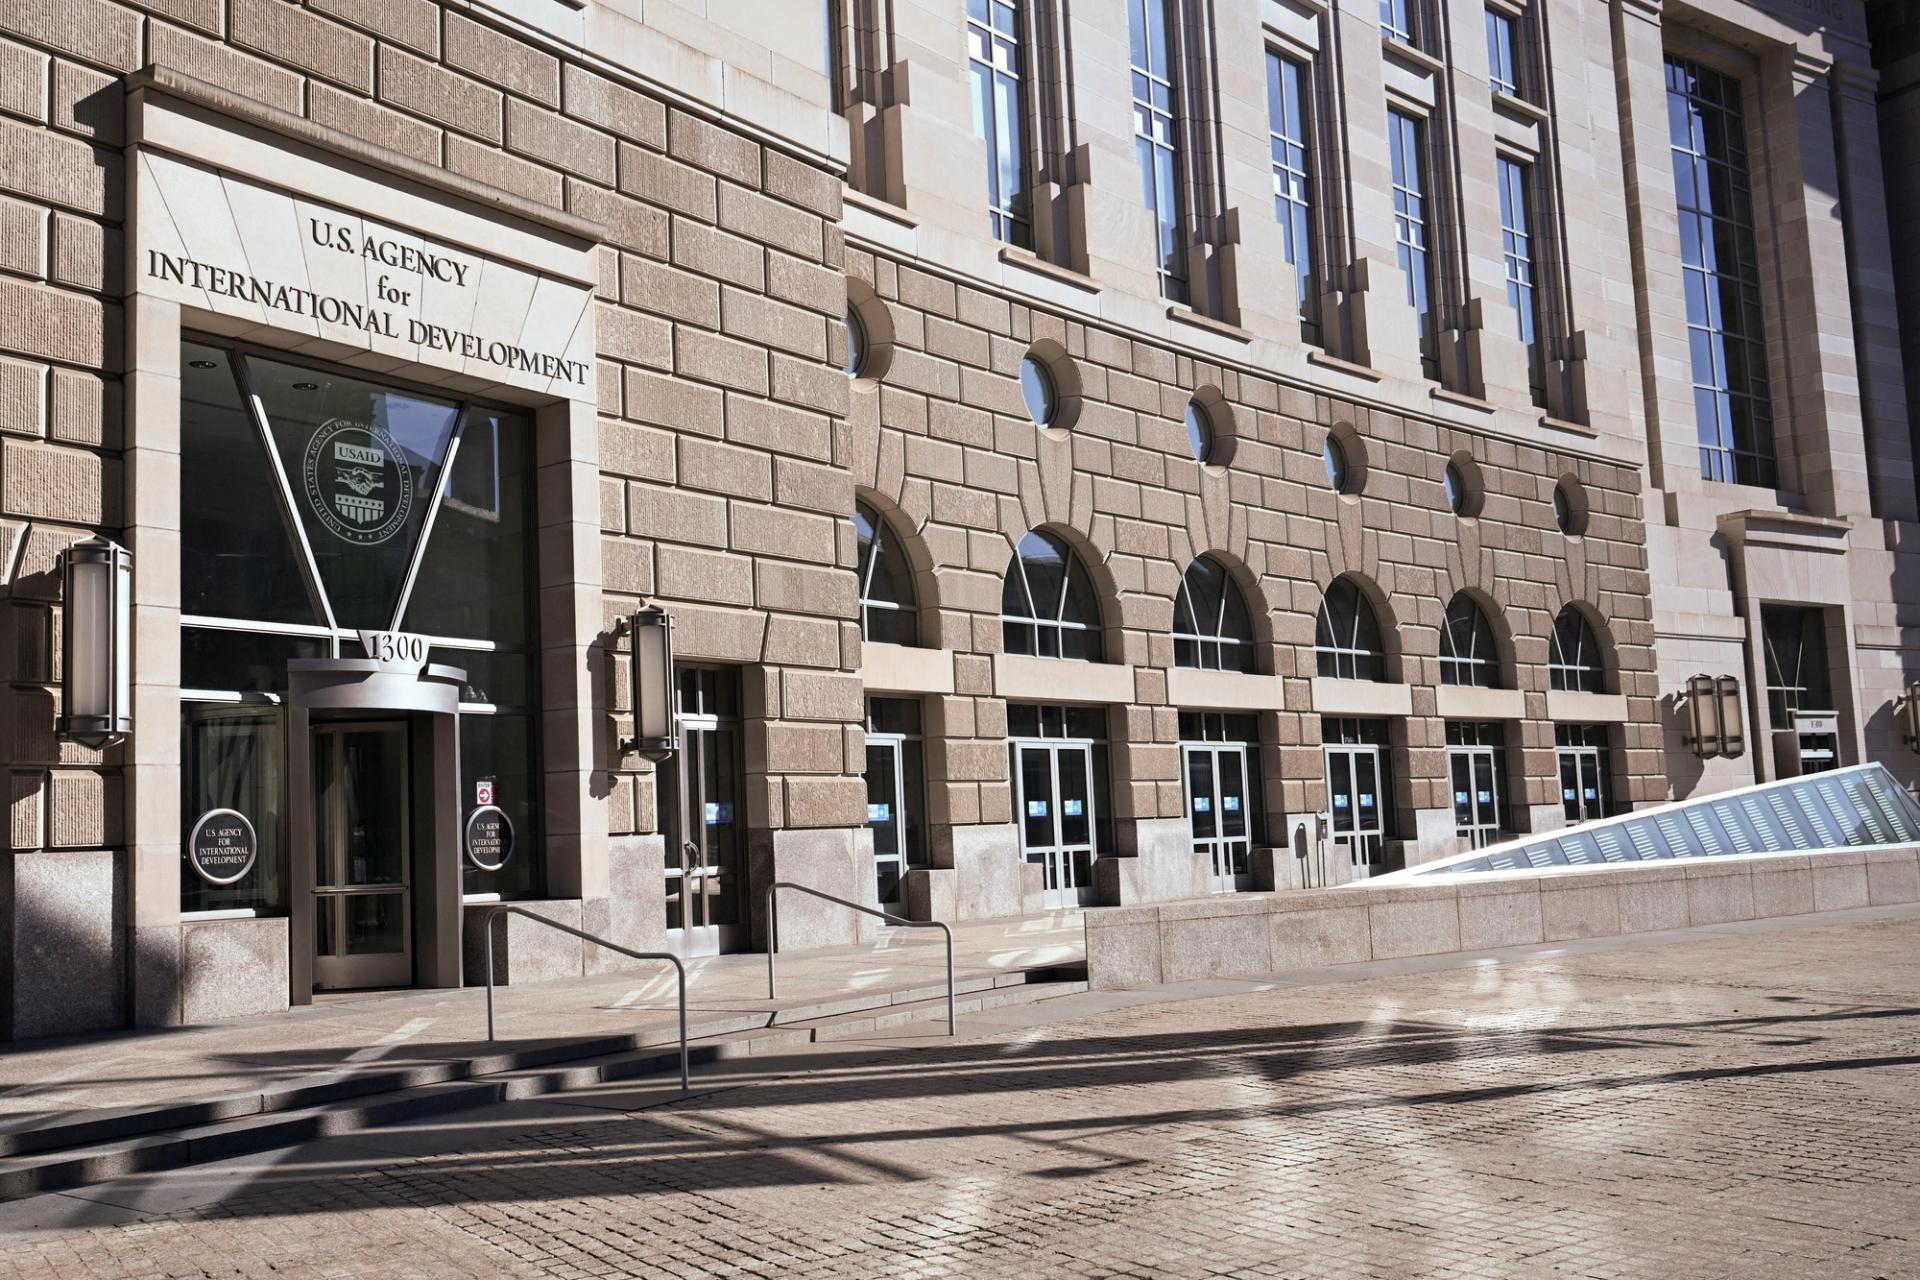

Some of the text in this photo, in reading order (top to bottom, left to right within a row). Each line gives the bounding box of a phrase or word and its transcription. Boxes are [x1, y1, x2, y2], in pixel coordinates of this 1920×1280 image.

[309, 217, 470, 288] U.S. AGENCY
[377, 275, 412, 307] for
[148, 249, 589, 385] INTERNATIONAL DEVELOPMENT
[310, 424, 334, 456] AGENCY
[338, 446, 381, 463] USAID
[307, 459, 317, 496] STATES
[315, 498, 341, 532] UNITED
[379, 480, 410, 538] DEVELOPMENT
[369, 633, 423, 662] 1300
[218, 828, 242, 837] AGENCY
[218, 838, 231, 846] FOR
[200, 846, 248, 856] INTERNATIONAL
[202, 856, 246, 865] DEVELOPMENT
